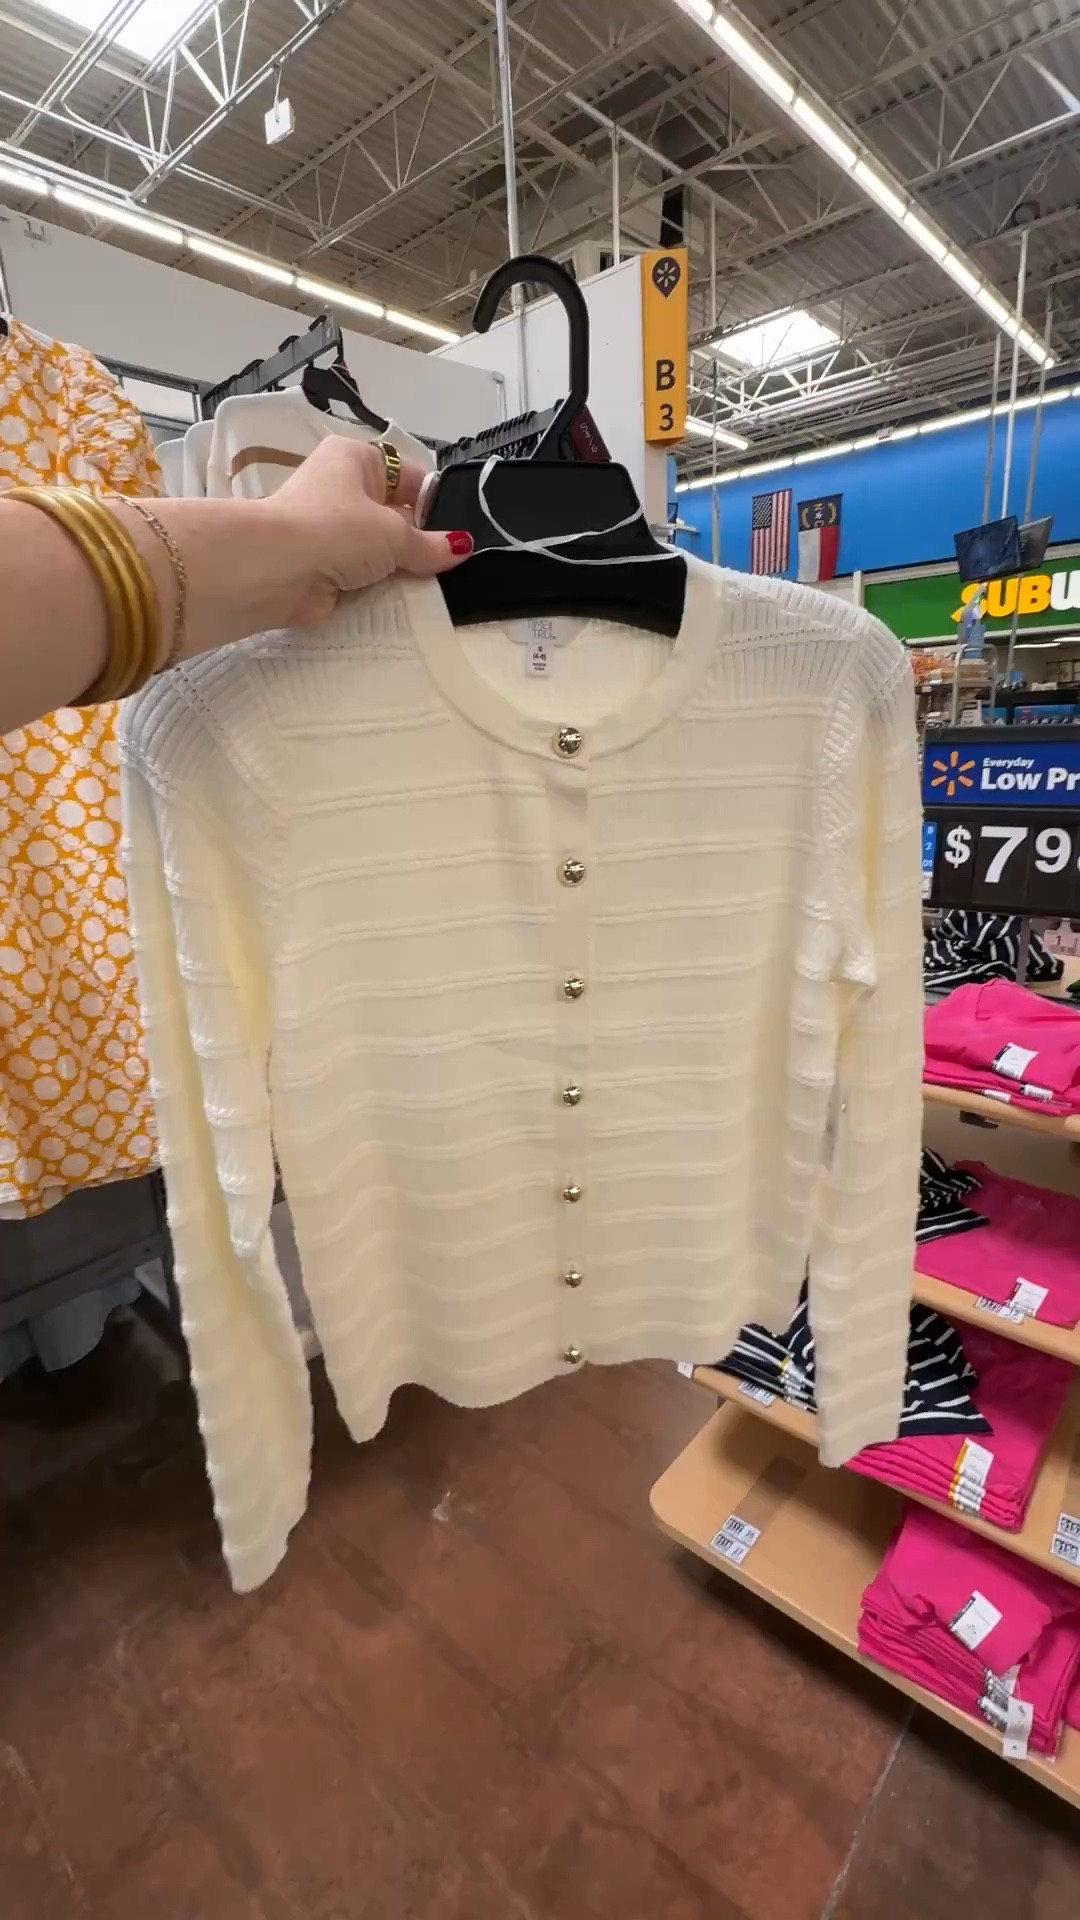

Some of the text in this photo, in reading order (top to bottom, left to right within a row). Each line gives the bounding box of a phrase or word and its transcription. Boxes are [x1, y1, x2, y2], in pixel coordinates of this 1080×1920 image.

[655, 358, 676, 391] B
[659, 403, 674, 431] 3
[982, 757, 1035, 769] Everyday
[980, 767, 1043, 790] Low
